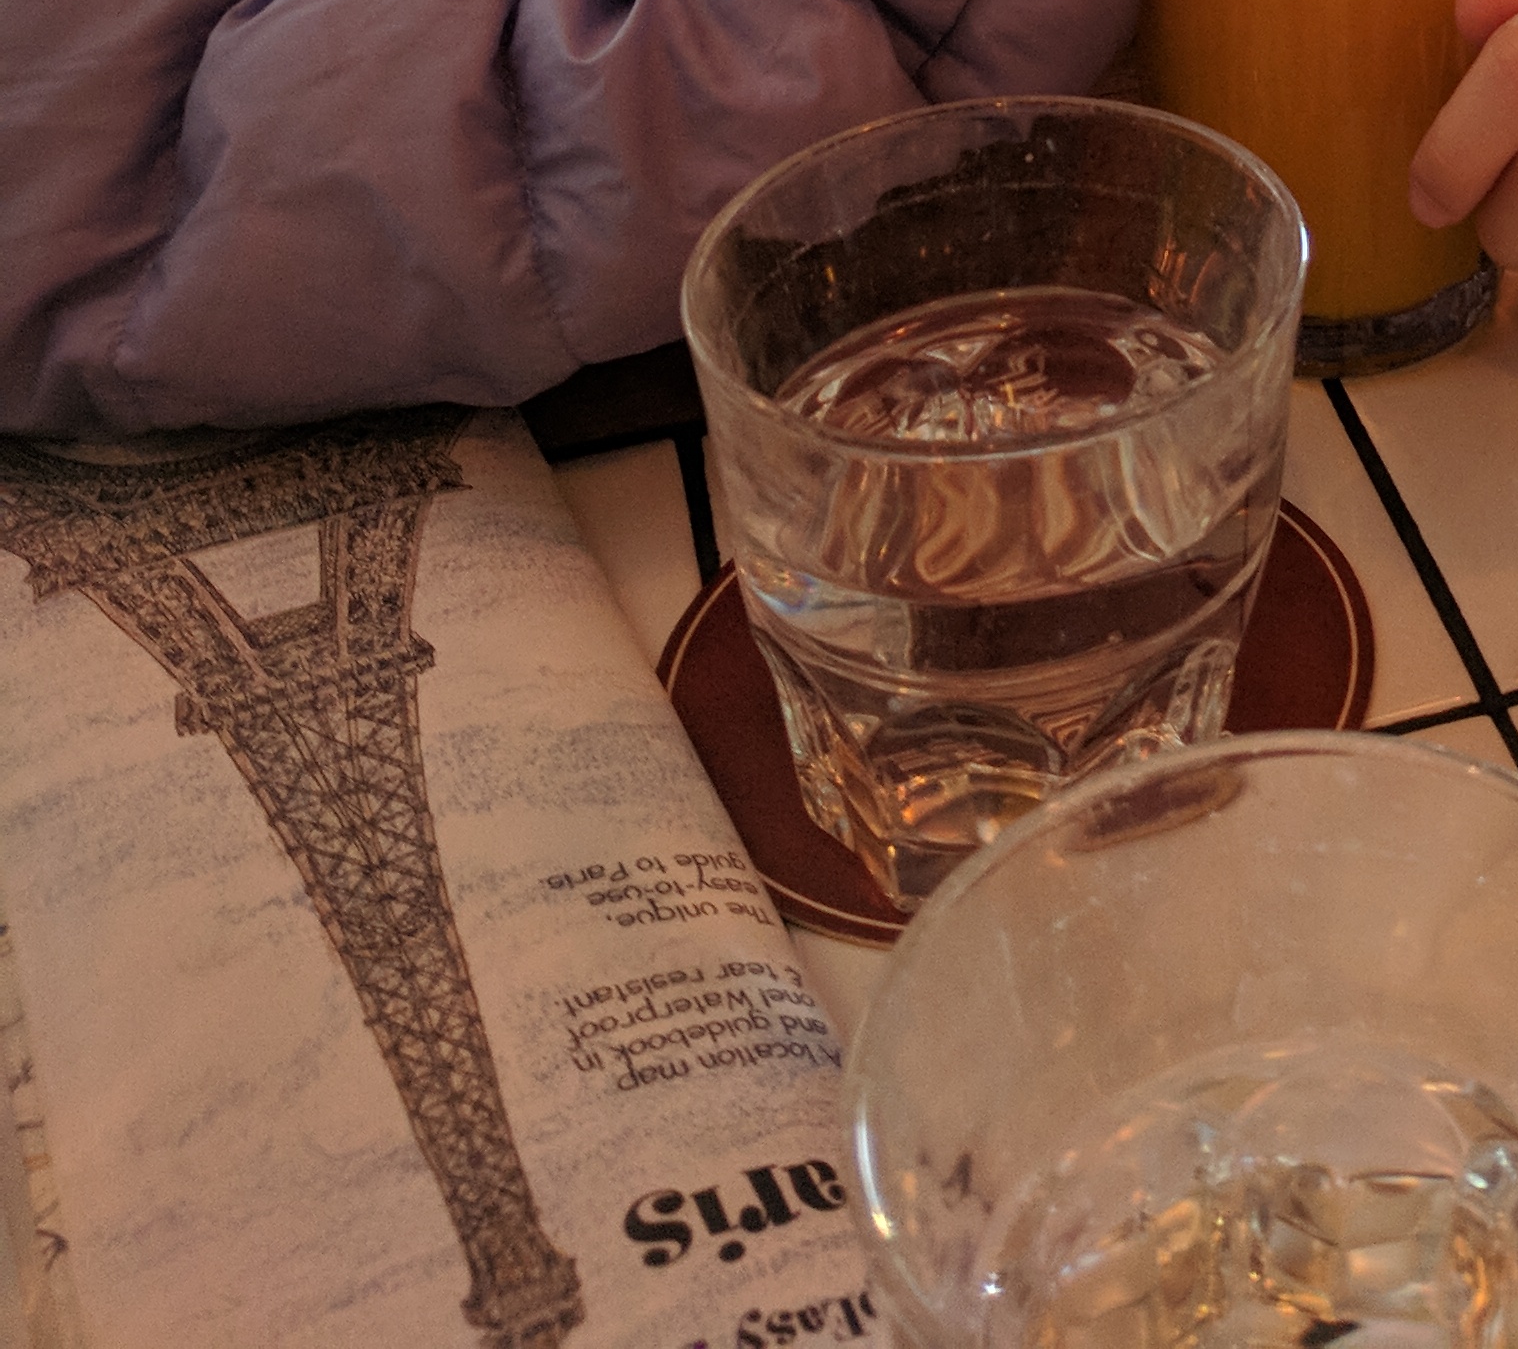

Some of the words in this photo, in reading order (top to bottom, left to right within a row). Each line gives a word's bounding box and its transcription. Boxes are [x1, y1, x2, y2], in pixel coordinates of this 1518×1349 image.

[634, 855, 666, 874] to
[673, 850, 746, 871] guide
[586, 868, 758, 906] easy-to-use
[724, 901, 774, 926] The
[715, 961, 778, 982] tear
[553, 968, 704, 1018] resistant.
[564, 989, 753, 1051] Waterproof
[778, 1013, 828, 1036] and
[607, 1008, 773, 1063] guidebook
[570, 1050, 605, 1073] in
[696, 1040, 819, 1070] location
[817, 1043, 842, 1069] A
[615, 1060, 690, 1092] map
[622, 1159, 847, 1268] aris
[735, 1291, 878, 1349] Easy
